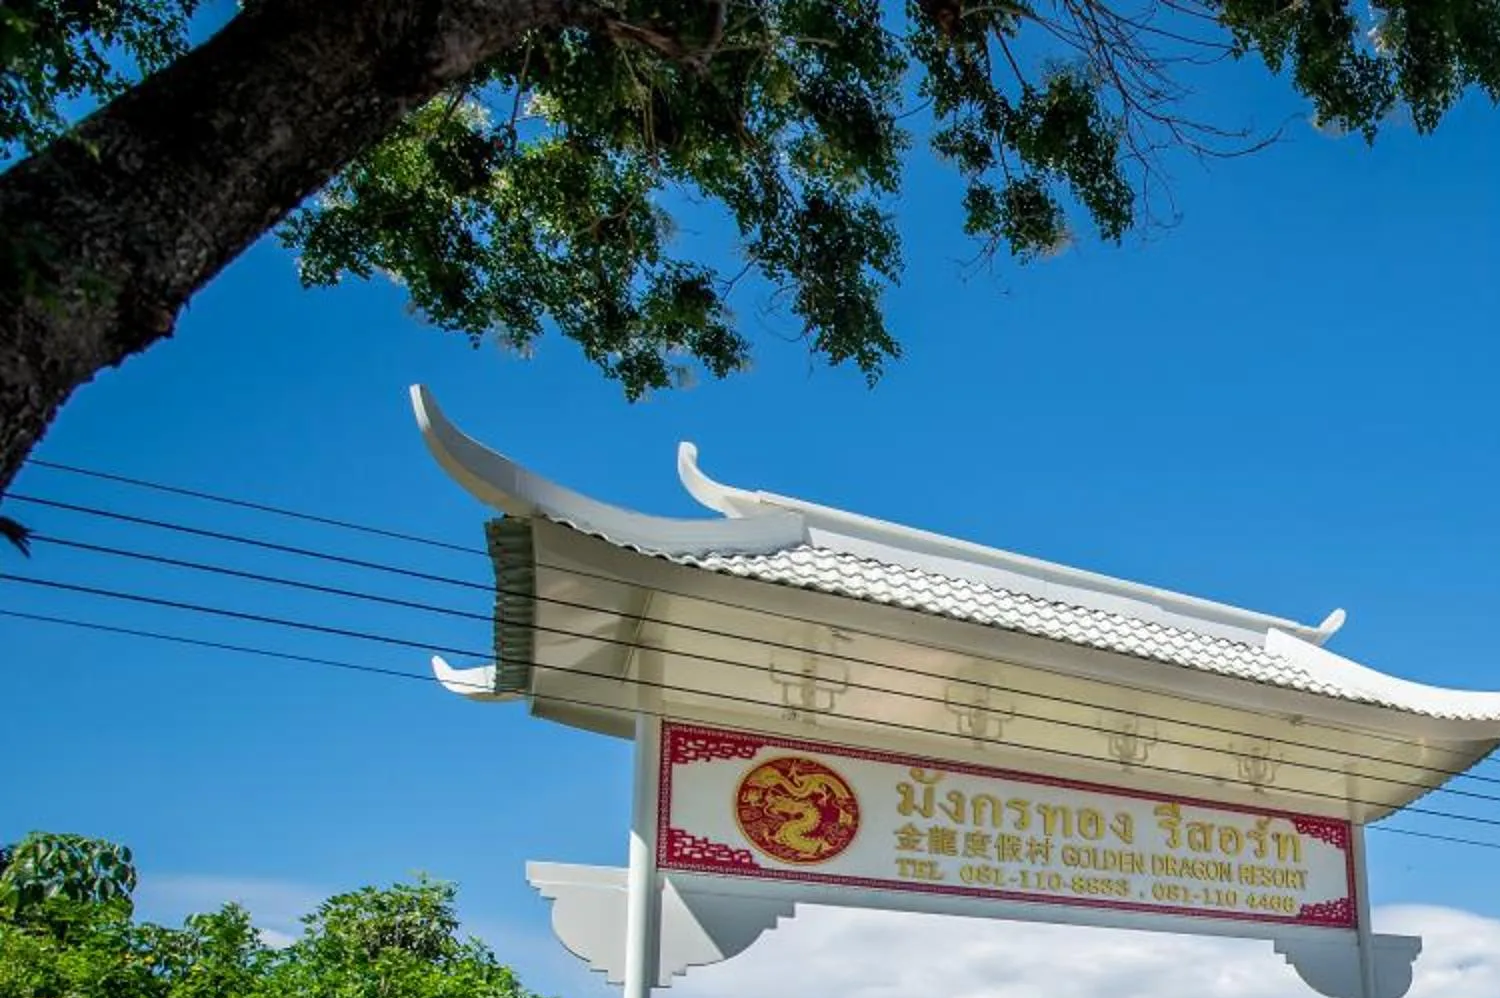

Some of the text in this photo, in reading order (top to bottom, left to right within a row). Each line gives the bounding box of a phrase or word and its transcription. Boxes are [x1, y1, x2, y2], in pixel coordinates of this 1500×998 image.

[895, 767, 1303, 863] มังกรทอง รีสอร์ท
[895, 857, 944, 881] TEL
[1061, 843, 1145, 875] GOLDEN
[1151, 854, 1237, 884] DRAGON
[1238, 864, 1308, 890] RESORT
